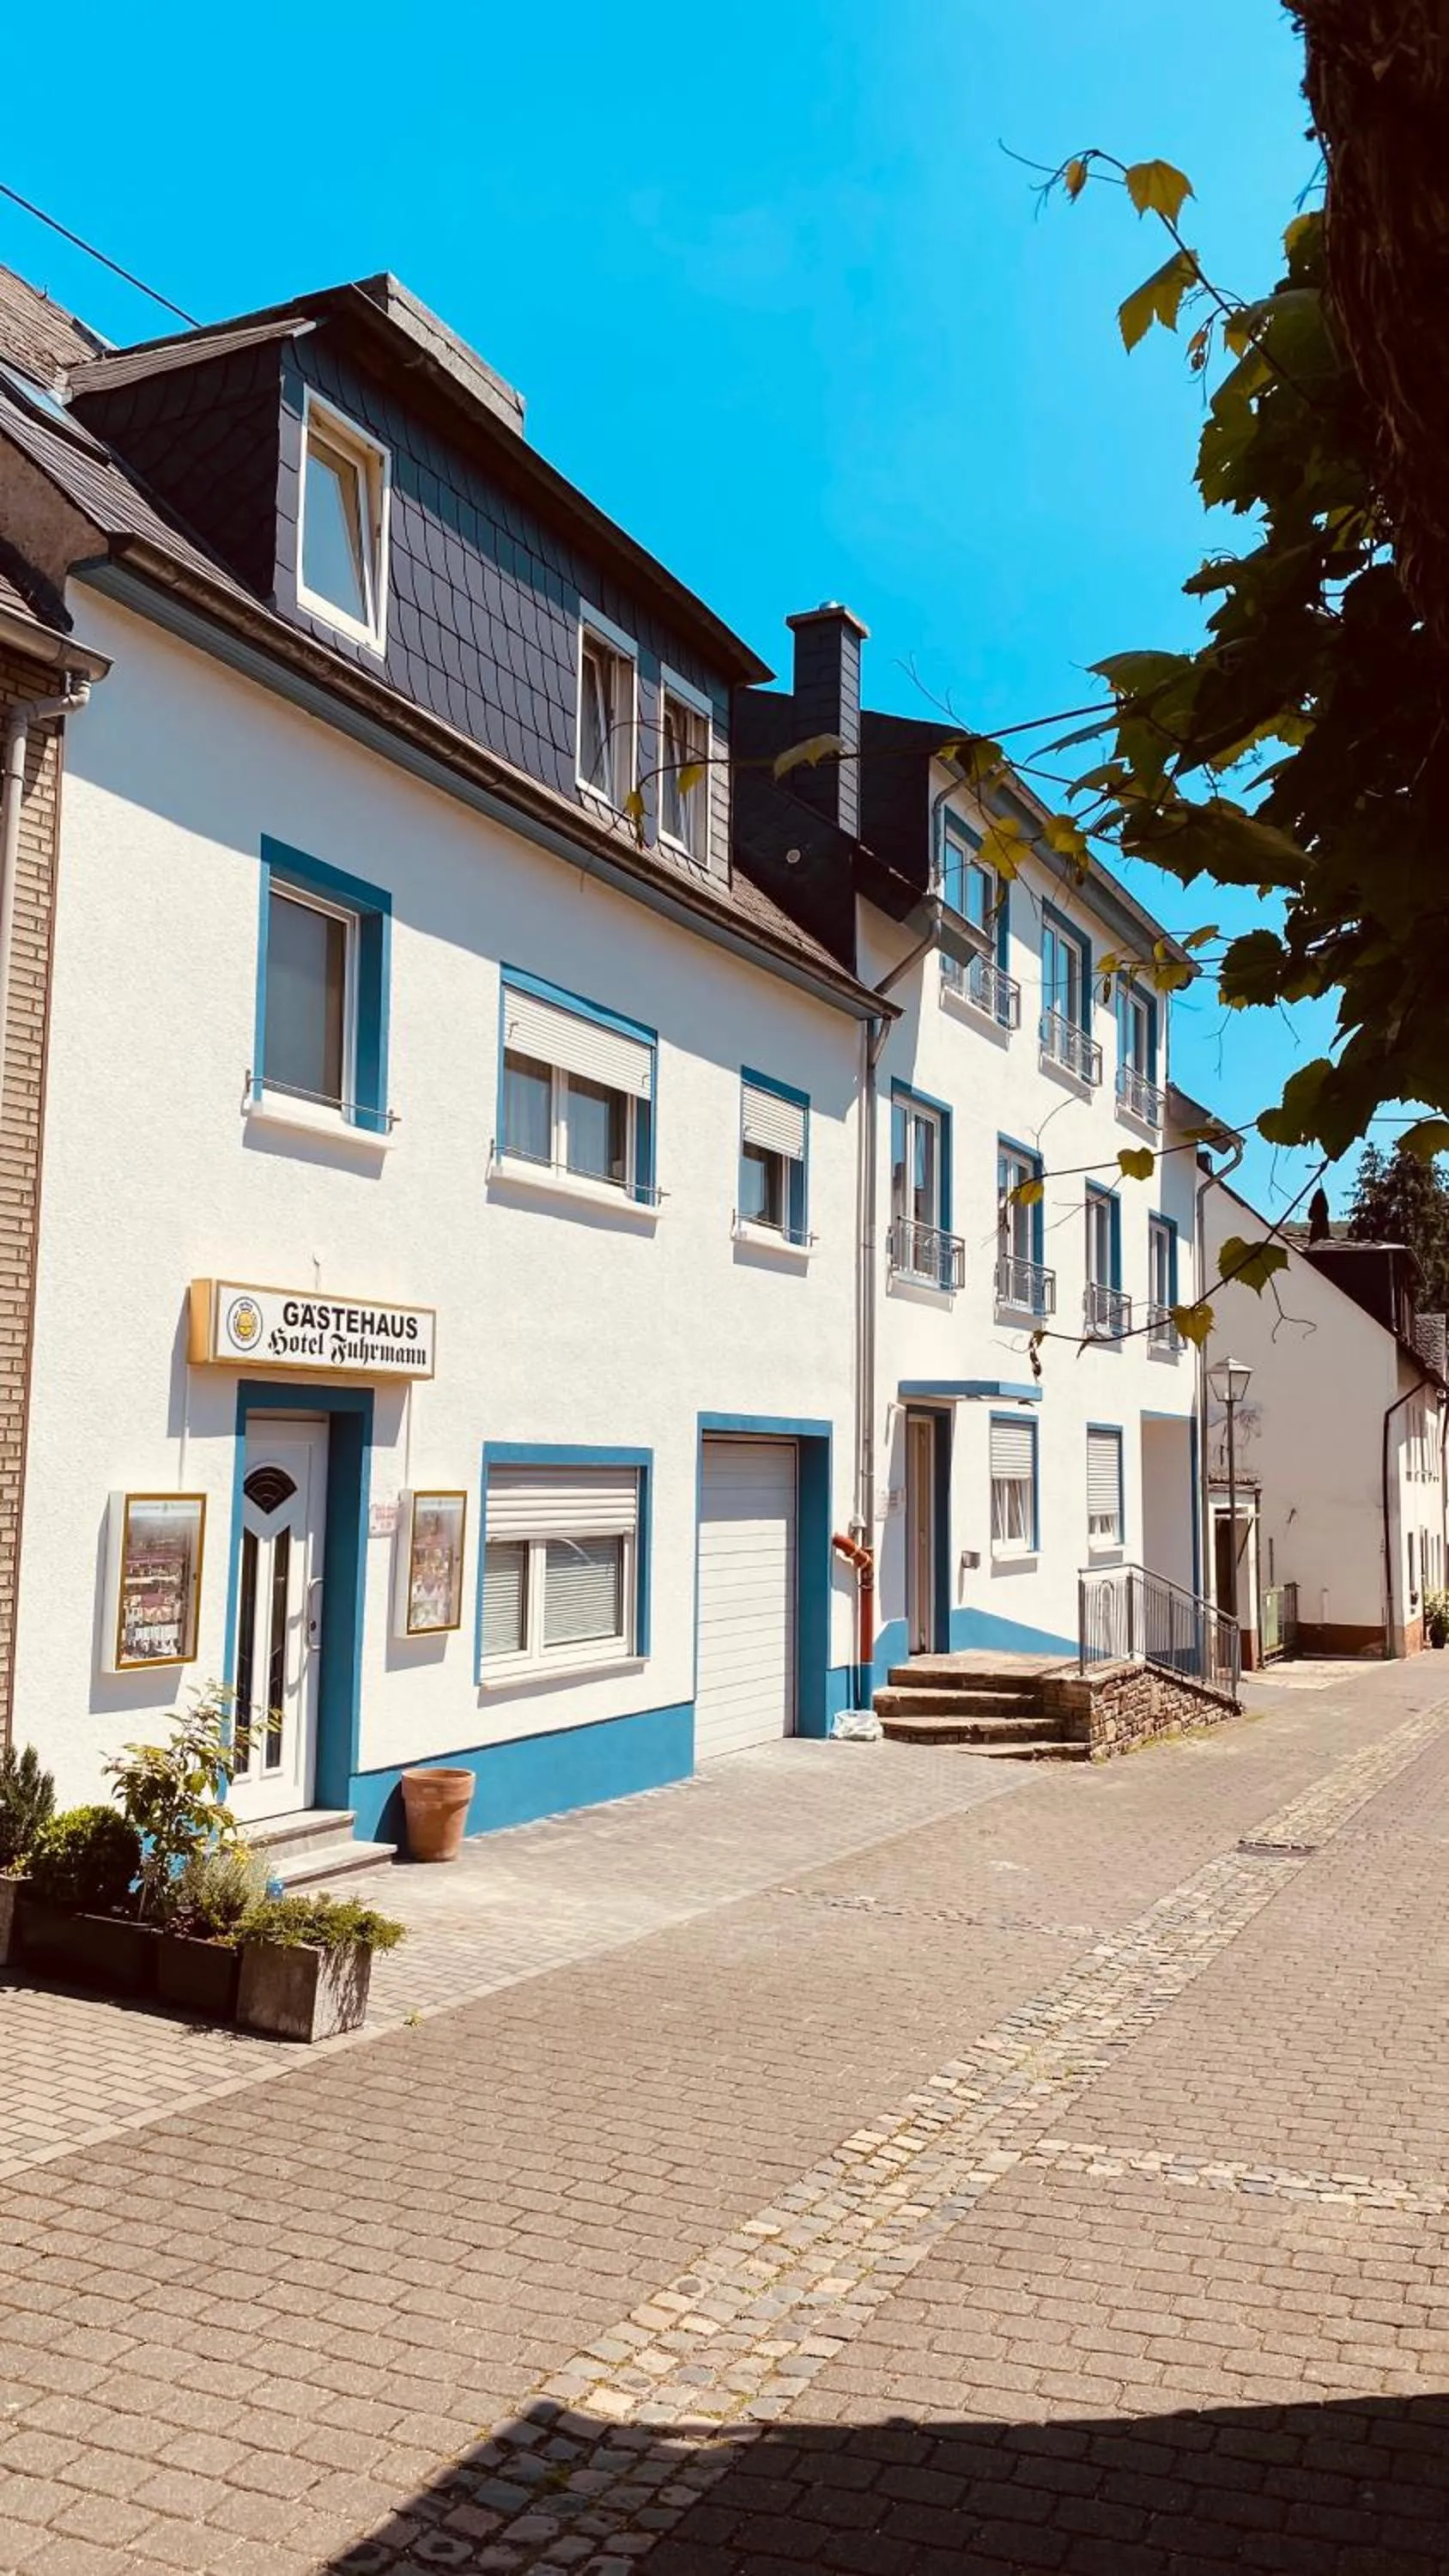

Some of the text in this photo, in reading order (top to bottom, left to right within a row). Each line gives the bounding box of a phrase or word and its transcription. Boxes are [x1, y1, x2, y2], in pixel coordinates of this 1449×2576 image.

[282, 1301, 418, 1340] GÄSTEHAUS
[268, 1327, 427, 1365] Hotel Fuhrmann
